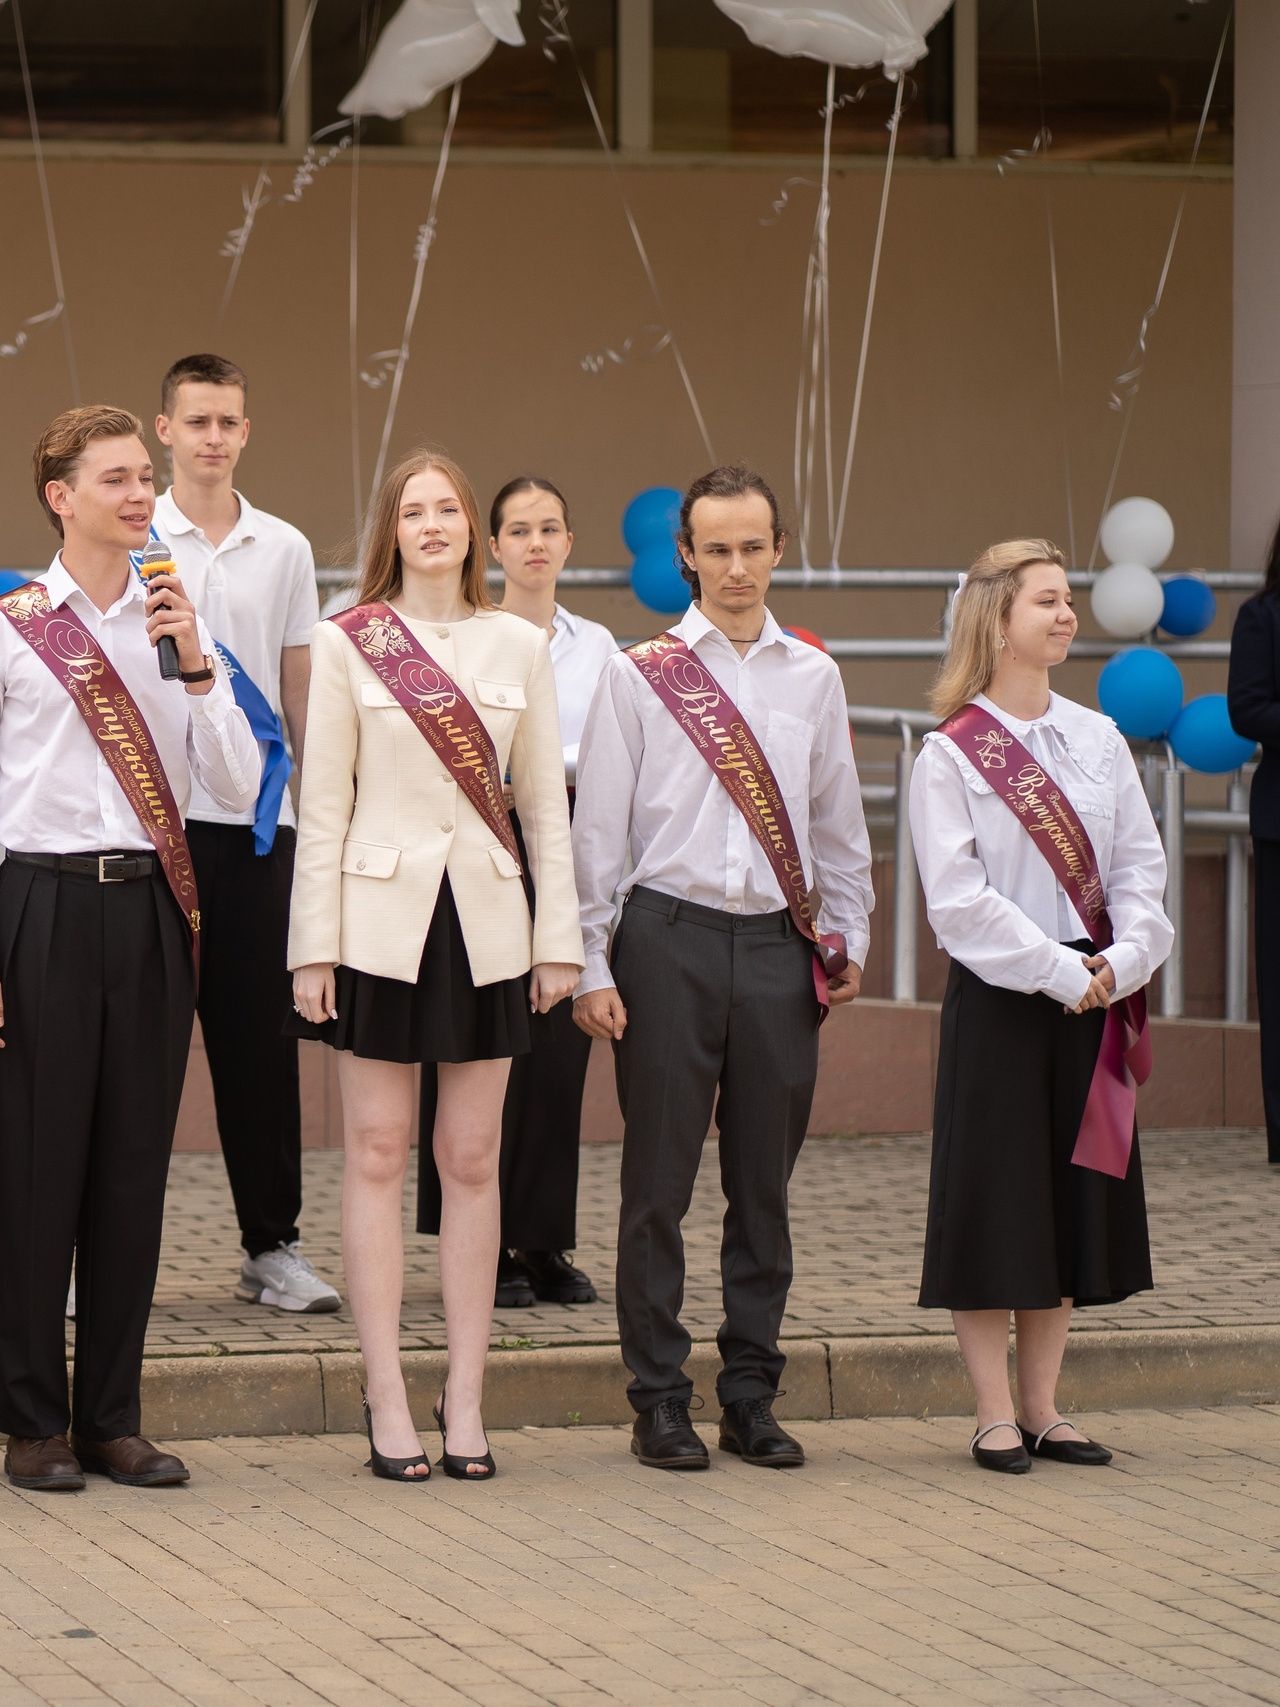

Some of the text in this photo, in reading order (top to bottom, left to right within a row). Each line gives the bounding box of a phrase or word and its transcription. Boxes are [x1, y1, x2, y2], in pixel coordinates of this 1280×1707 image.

[45, 619, 194, 896] Выпускник 2026
[114, 692, 167, 791] Дубравкин Андрей
[468, 722, 493, 761] Грачева
[661, 653, 787, 854] Выпускник
[730, 722, 764, 771] Стуканов
[759, 770, 781, 810] Андрей
[1008, 763, 1086, 885] Выпускница
